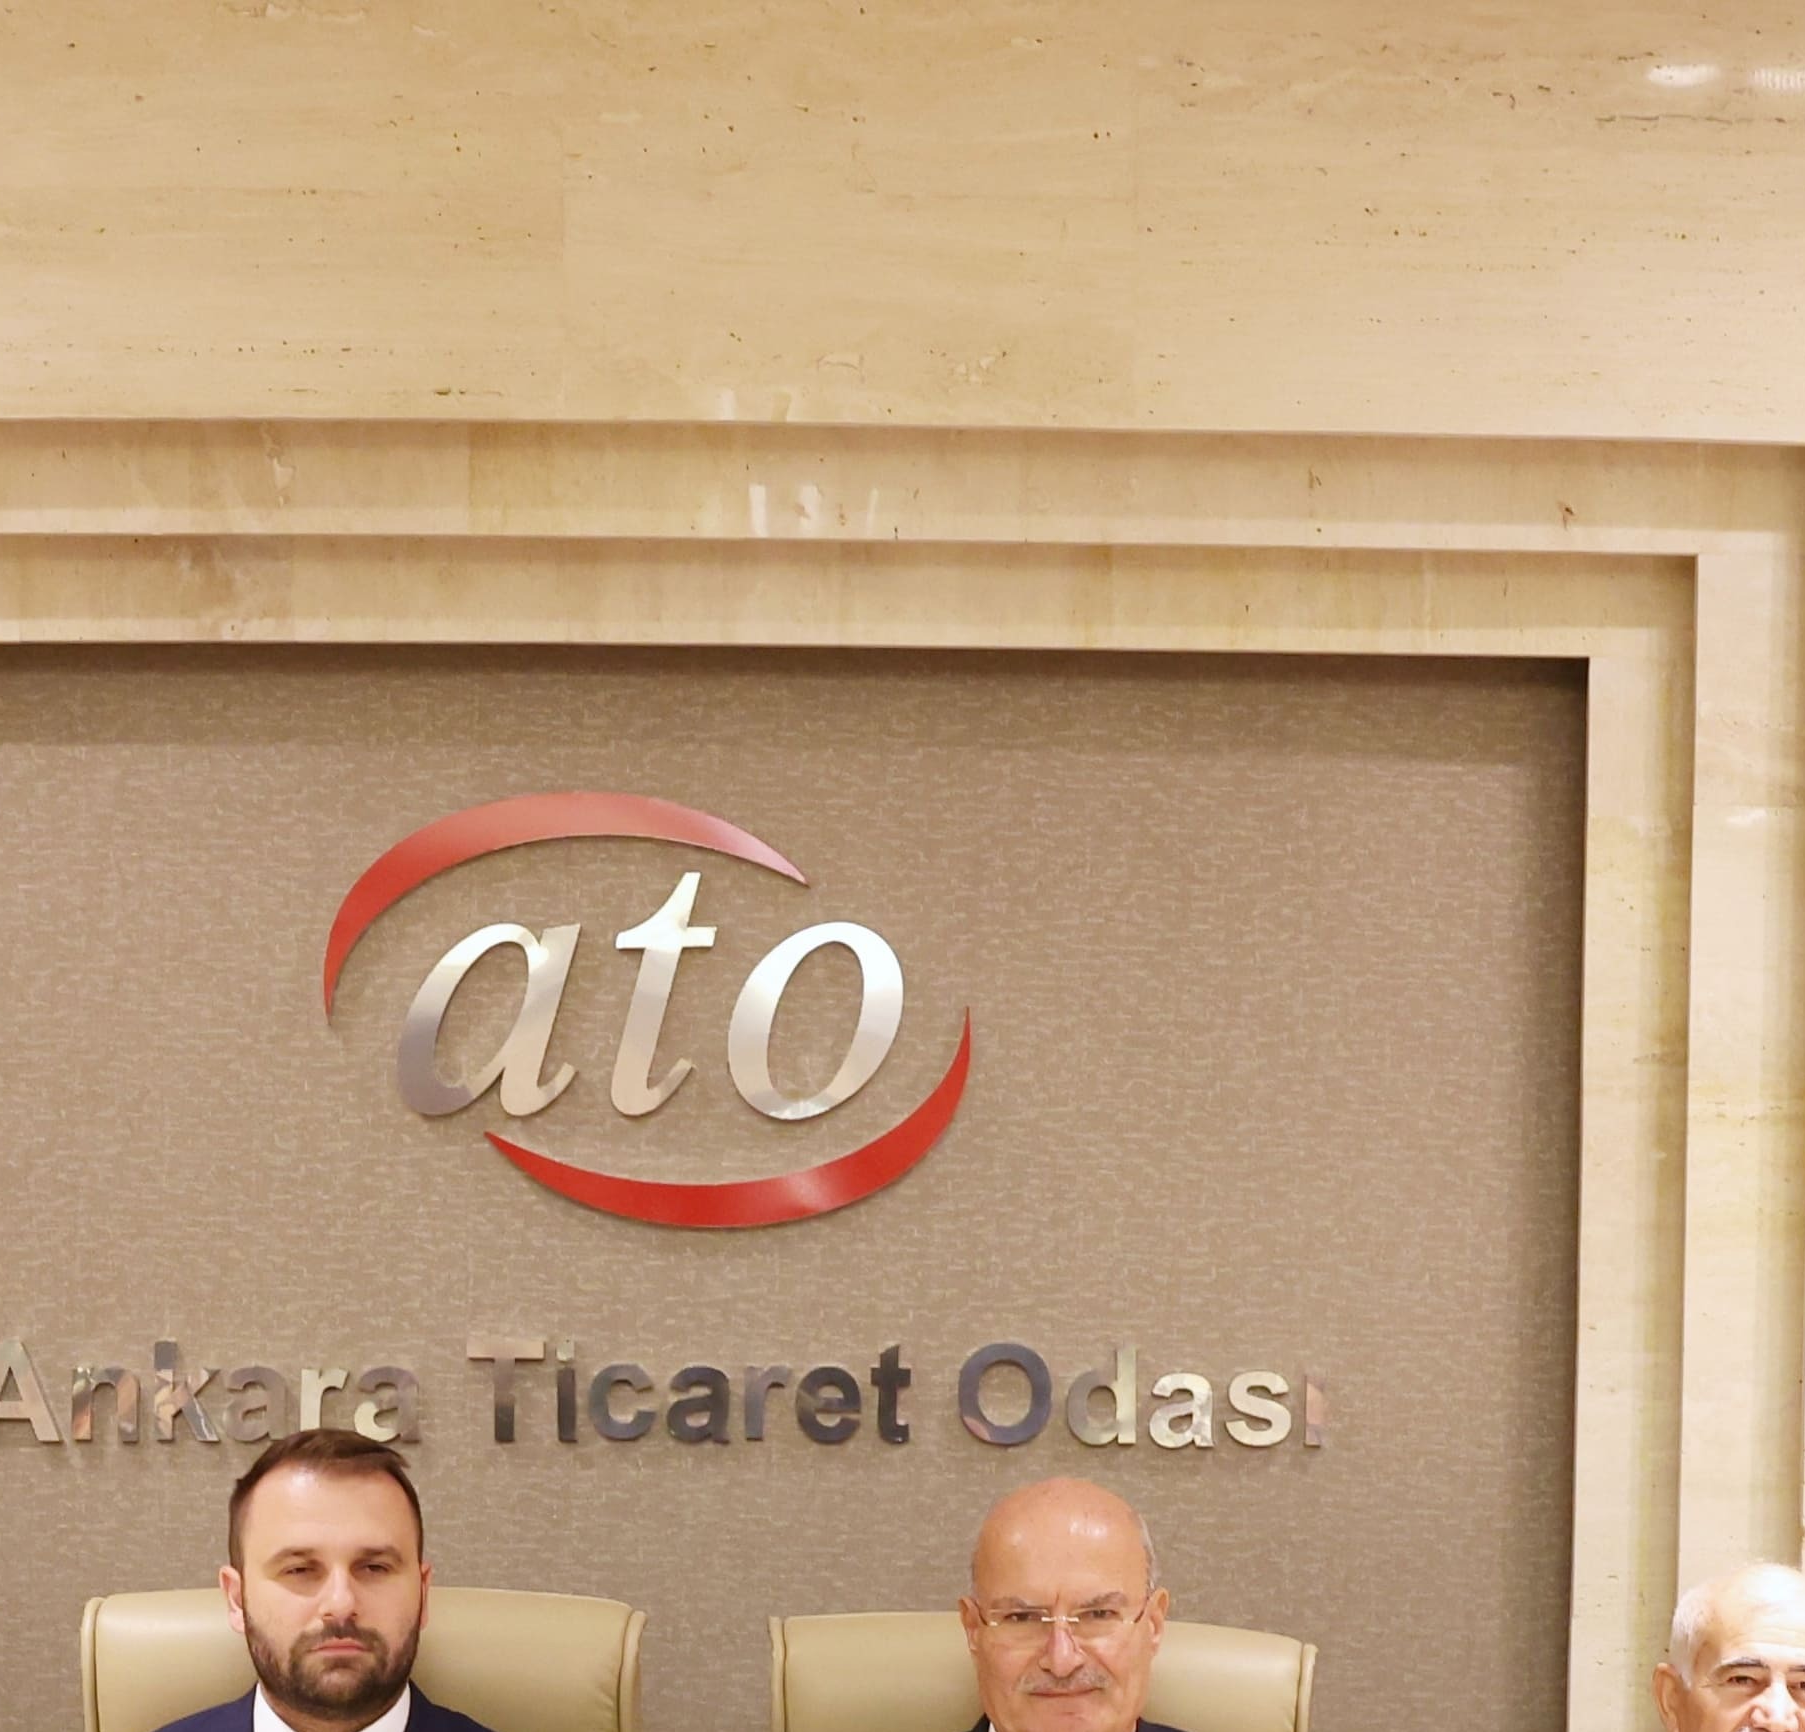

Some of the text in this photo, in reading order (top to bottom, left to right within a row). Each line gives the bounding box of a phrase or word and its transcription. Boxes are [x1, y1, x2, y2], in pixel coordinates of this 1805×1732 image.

[398, 872, 906, 1120] ato
[467, 1339, 912, 1446] Ticaret
[957, 1341, 1327, 1449] Odası
